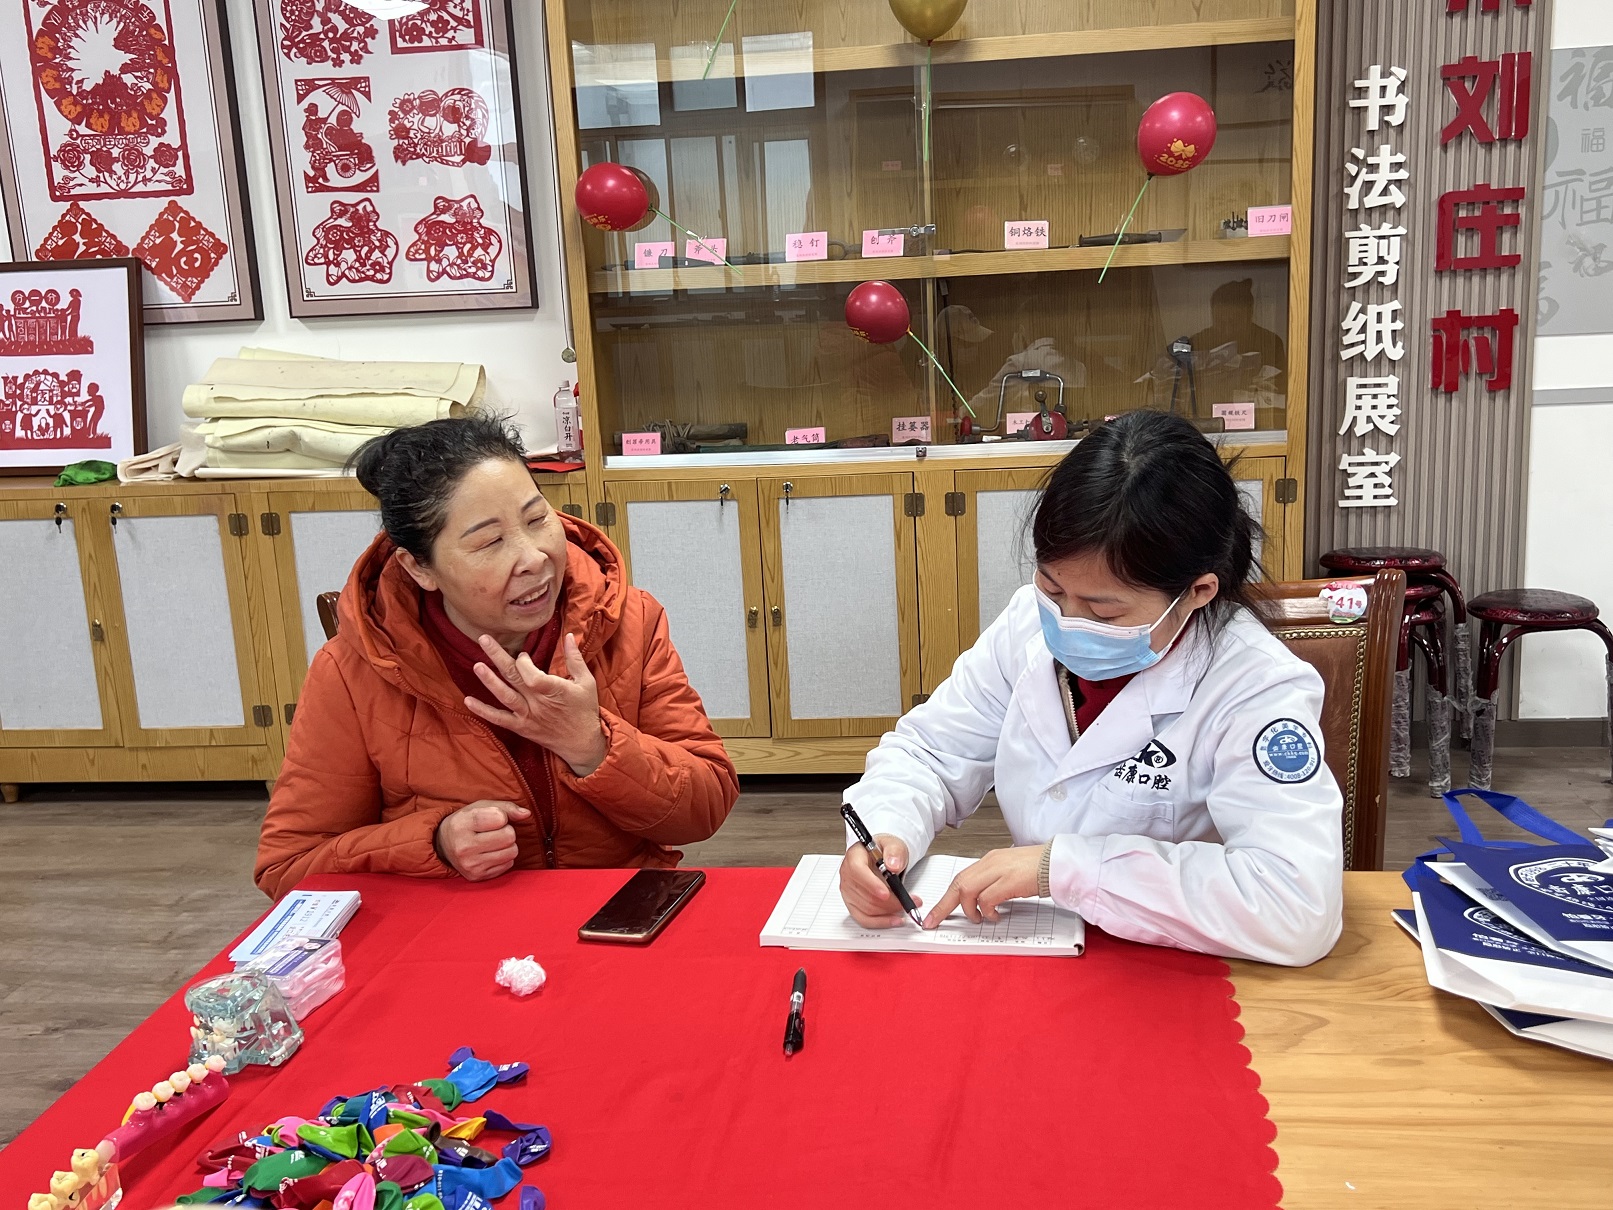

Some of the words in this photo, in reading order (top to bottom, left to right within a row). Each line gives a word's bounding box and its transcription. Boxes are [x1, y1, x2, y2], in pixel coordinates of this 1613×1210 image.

[1581, 128, 1605, 153] 福
[1429, 0, 1532, 392] 刘庄村
[1008, 226, 1047, 238] 铜烙铁
[643, 248, 668, 258] 镰刀
[1338, 65, 1410, 508] 书法剪纸展室
[562, 415, 573, 441] 凉白开
[790, 433, 821, 444] 老气筒
